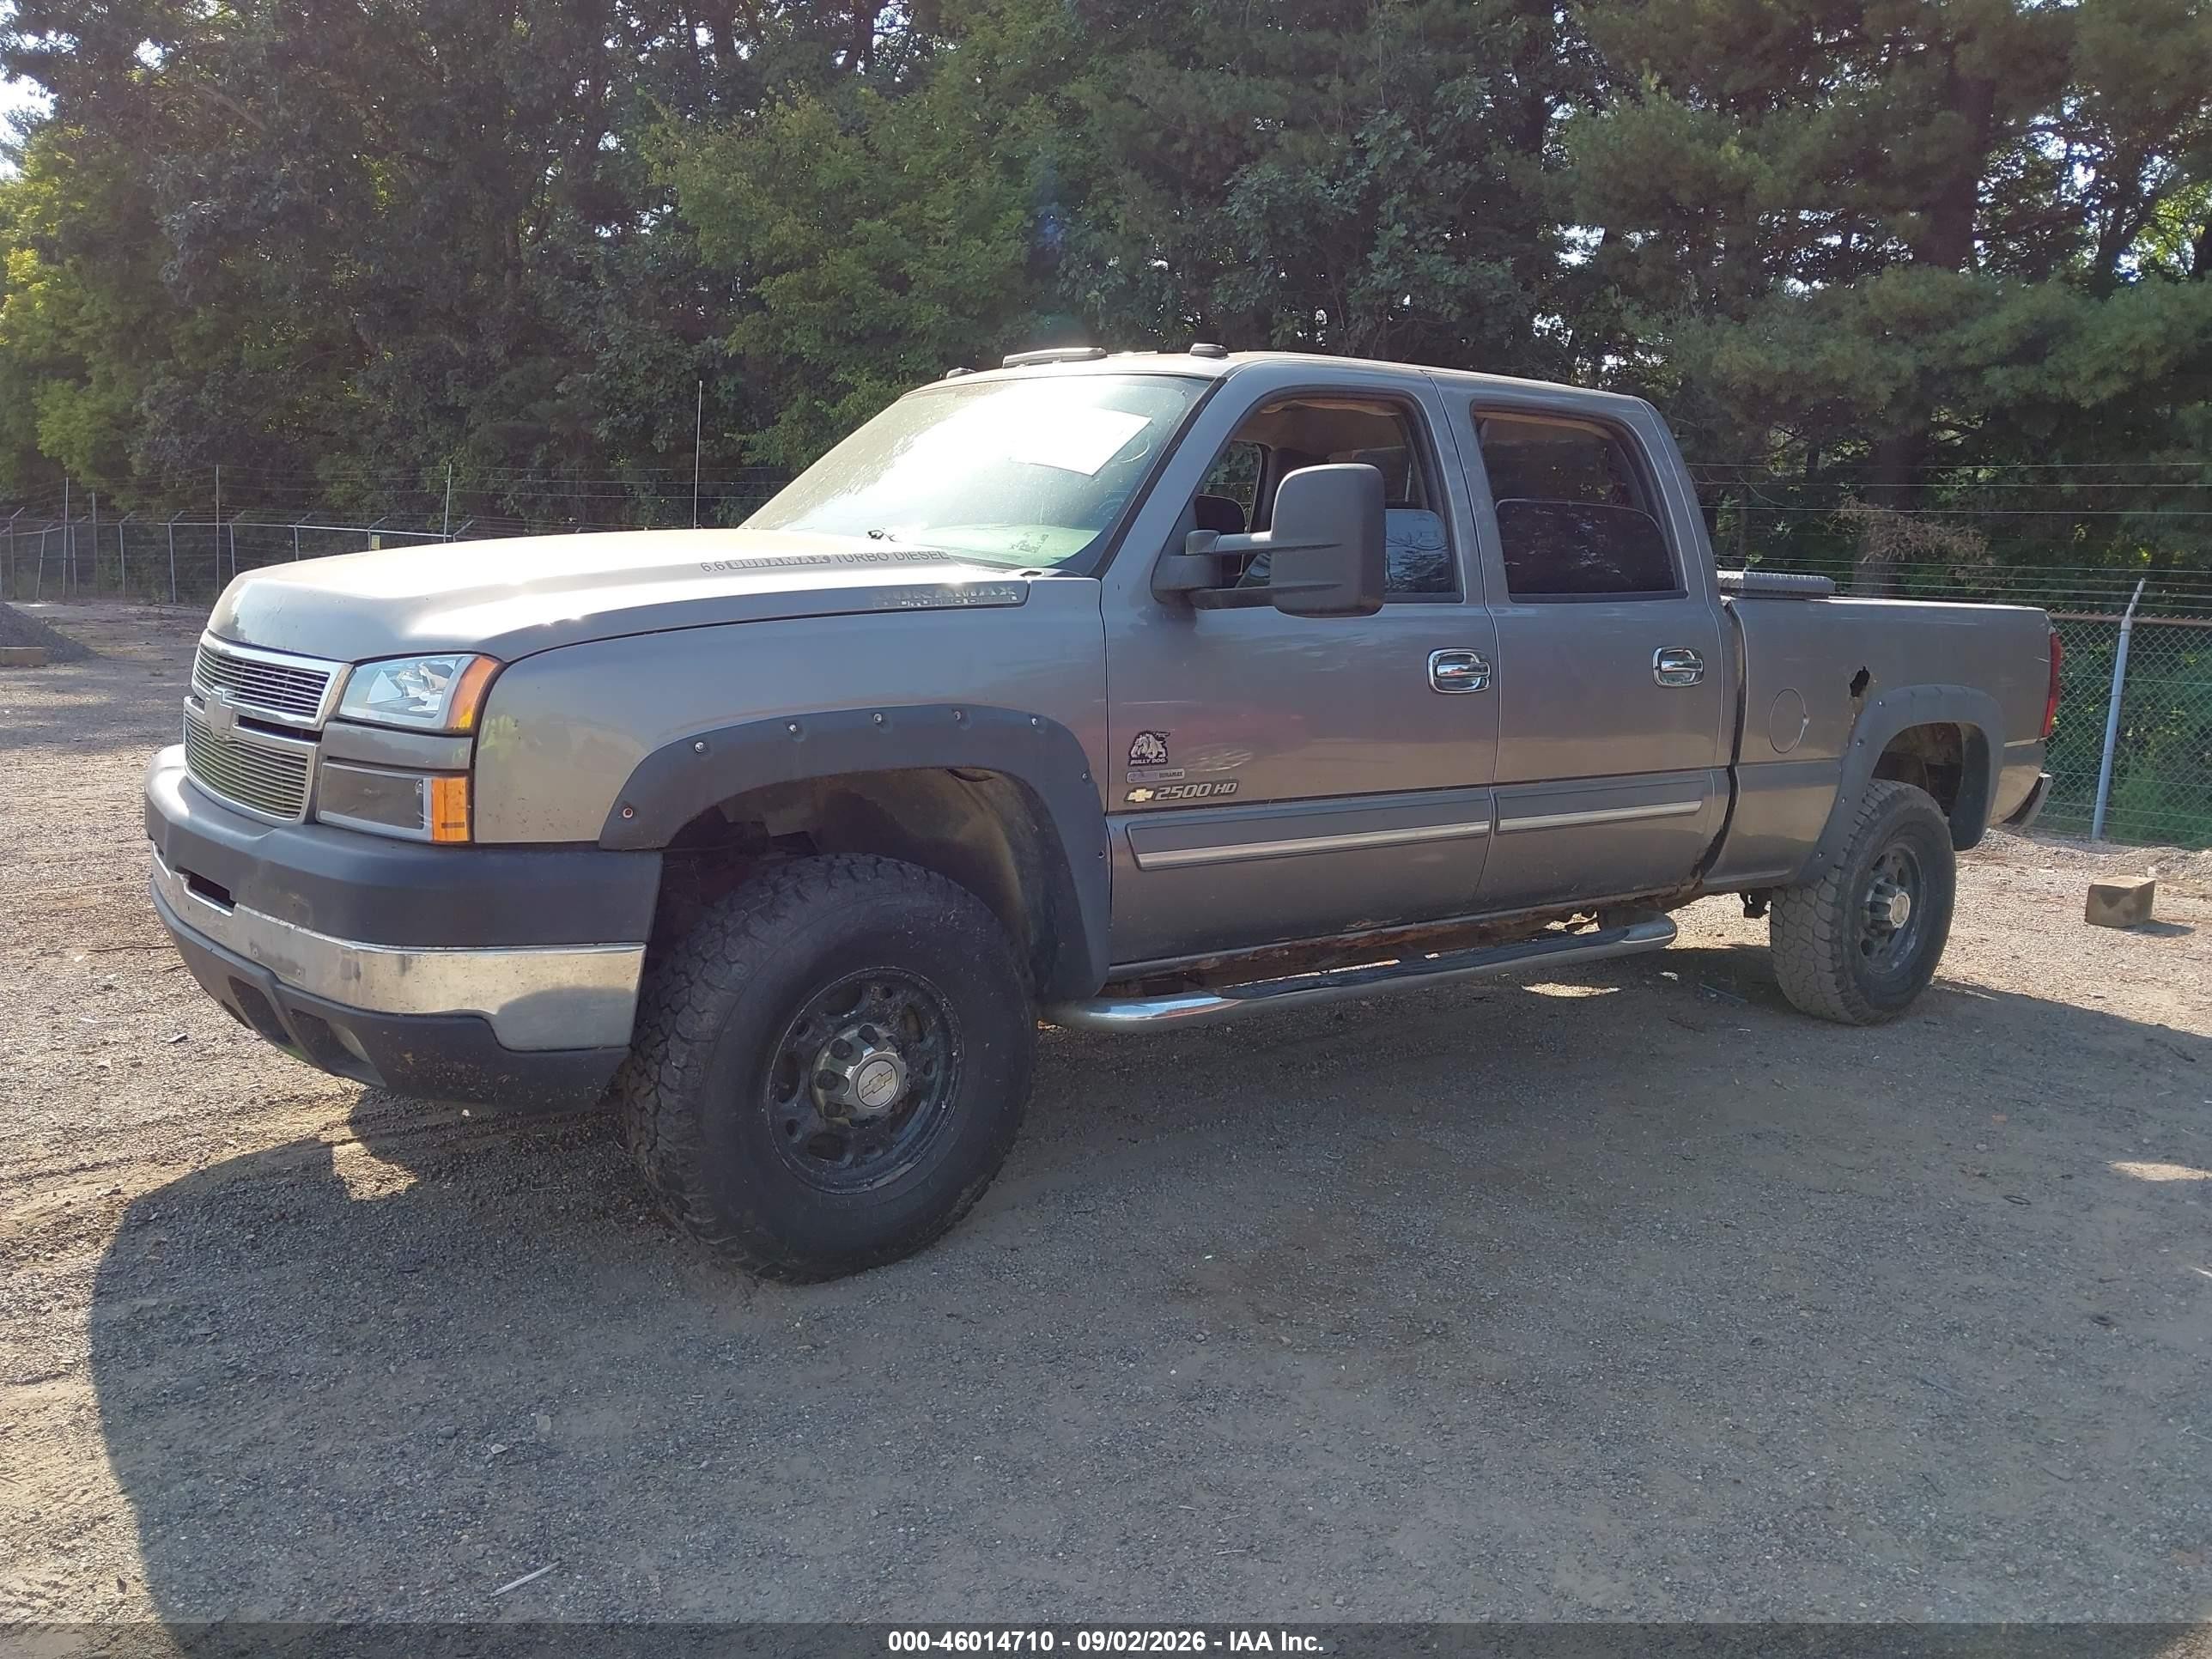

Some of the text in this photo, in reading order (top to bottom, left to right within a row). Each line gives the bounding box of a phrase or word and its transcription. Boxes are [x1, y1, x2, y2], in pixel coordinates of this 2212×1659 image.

[700, 561, 726, 573] 6.6
[836, 552, 890, 563] TURBO
[895, 550, 949, 561] DIESEL
[1155, 782, 1237, 799] 2500 HD
